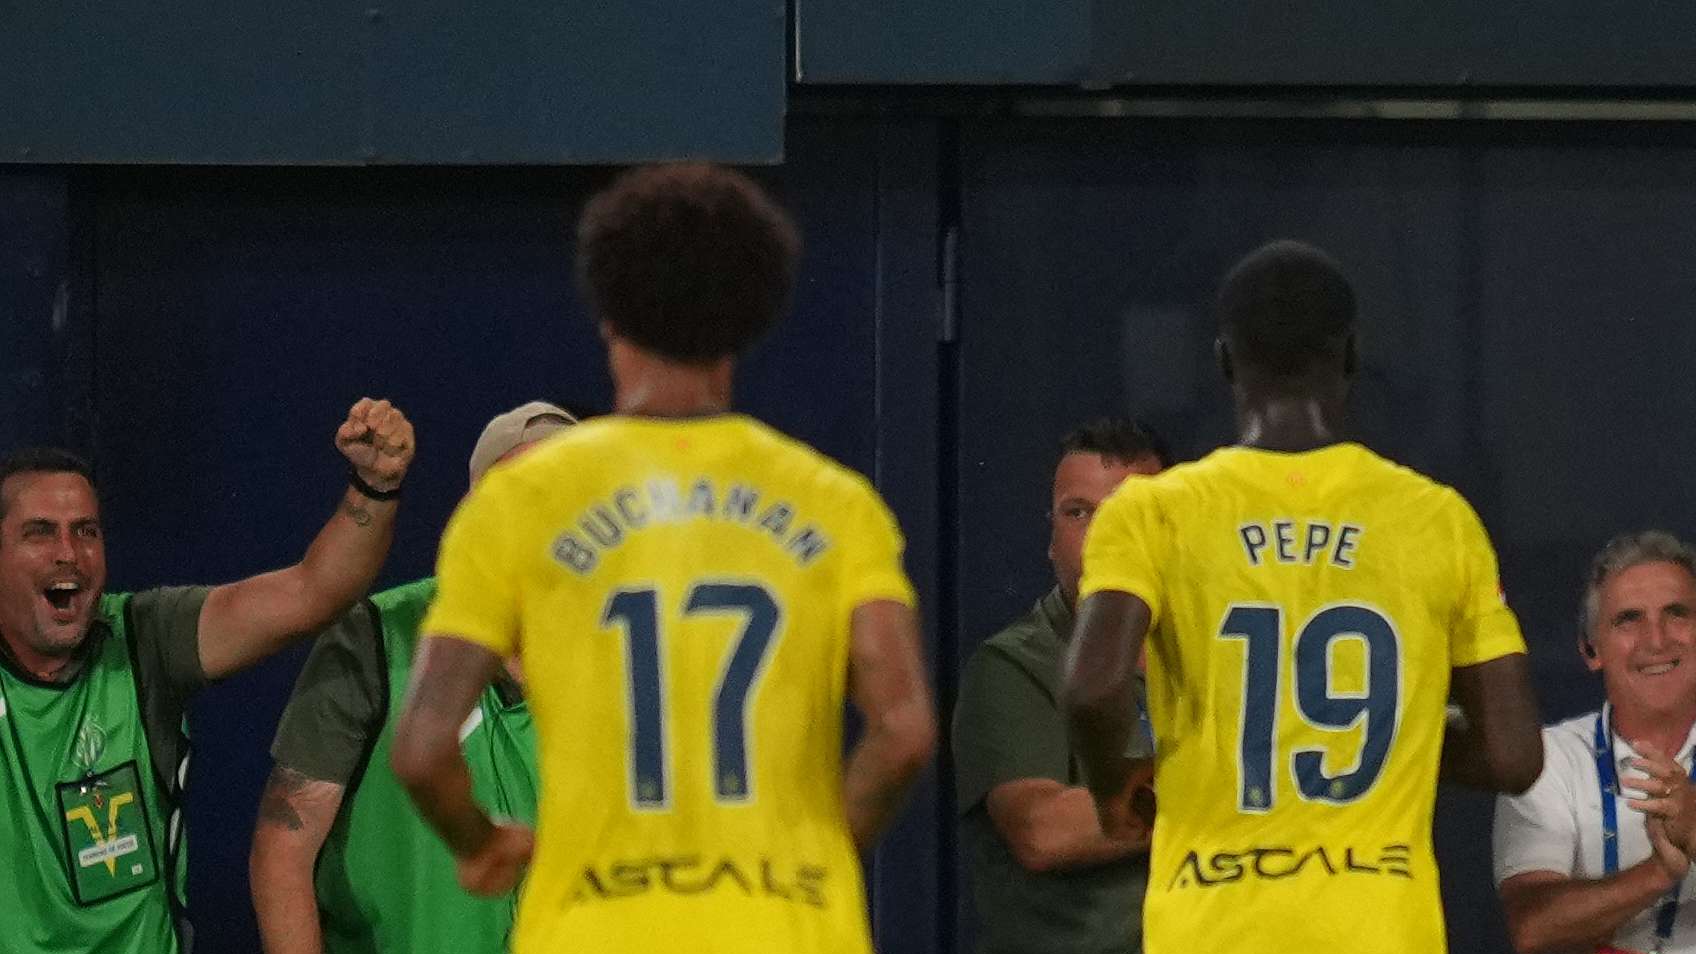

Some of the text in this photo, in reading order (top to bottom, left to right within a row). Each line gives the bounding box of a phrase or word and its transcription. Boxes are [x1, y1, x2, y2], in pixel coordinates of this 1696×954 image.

[553, 478, 828, 574] BUCANAN
[1239, 521, 1362, 570] PEPE
[602, 584, 781, 808] 17
[1219, 605, 1400, 811] 19
